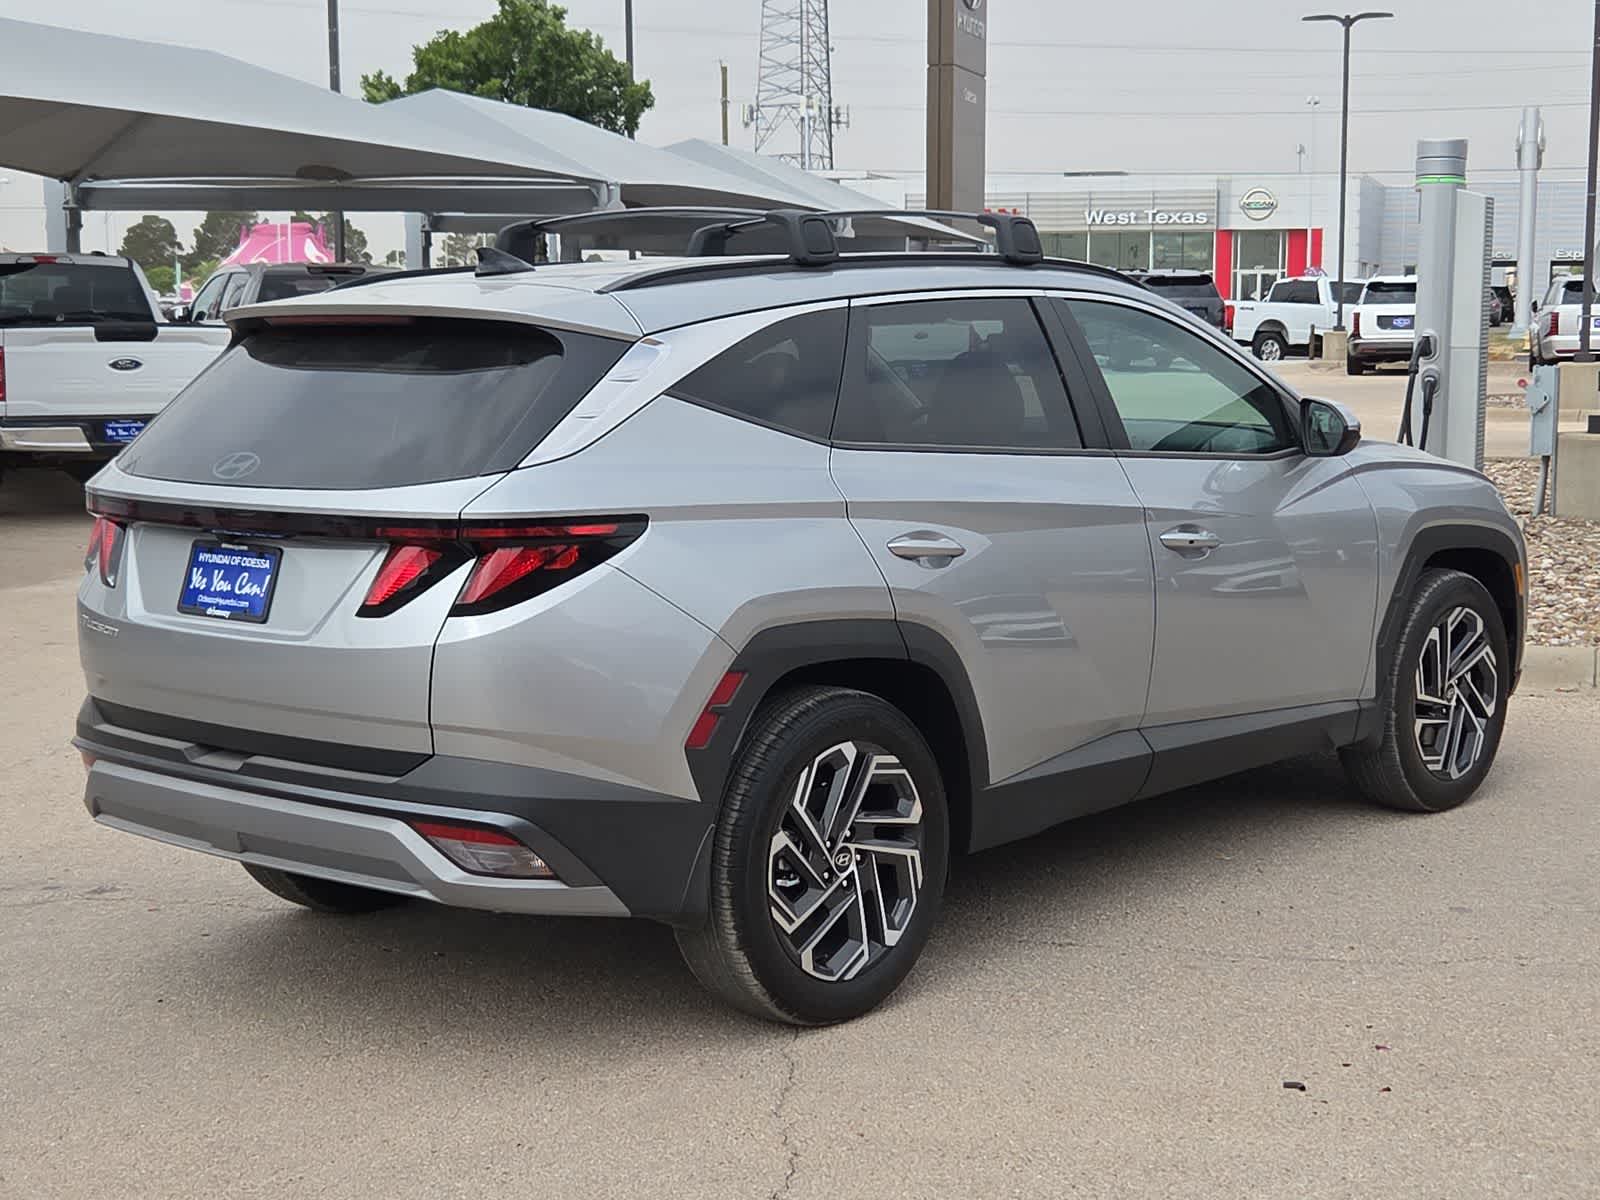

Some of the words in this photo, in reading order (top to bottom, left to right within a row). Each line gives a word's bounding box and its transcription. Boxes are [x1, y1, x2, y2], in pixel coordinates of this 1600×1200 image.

[1084, 209, 1137, 225] West
[1144, 209, 1208, 225] Texas
[199, 552, 230, 565] HYUNDAI
[230, 556, 241, 566] OF
[241, 557, 270, 569] ODESSA
[189, 567, 207, 590] Yes
[210, 569, 232, 592] You
[234, 571, 271, 598] Can!
